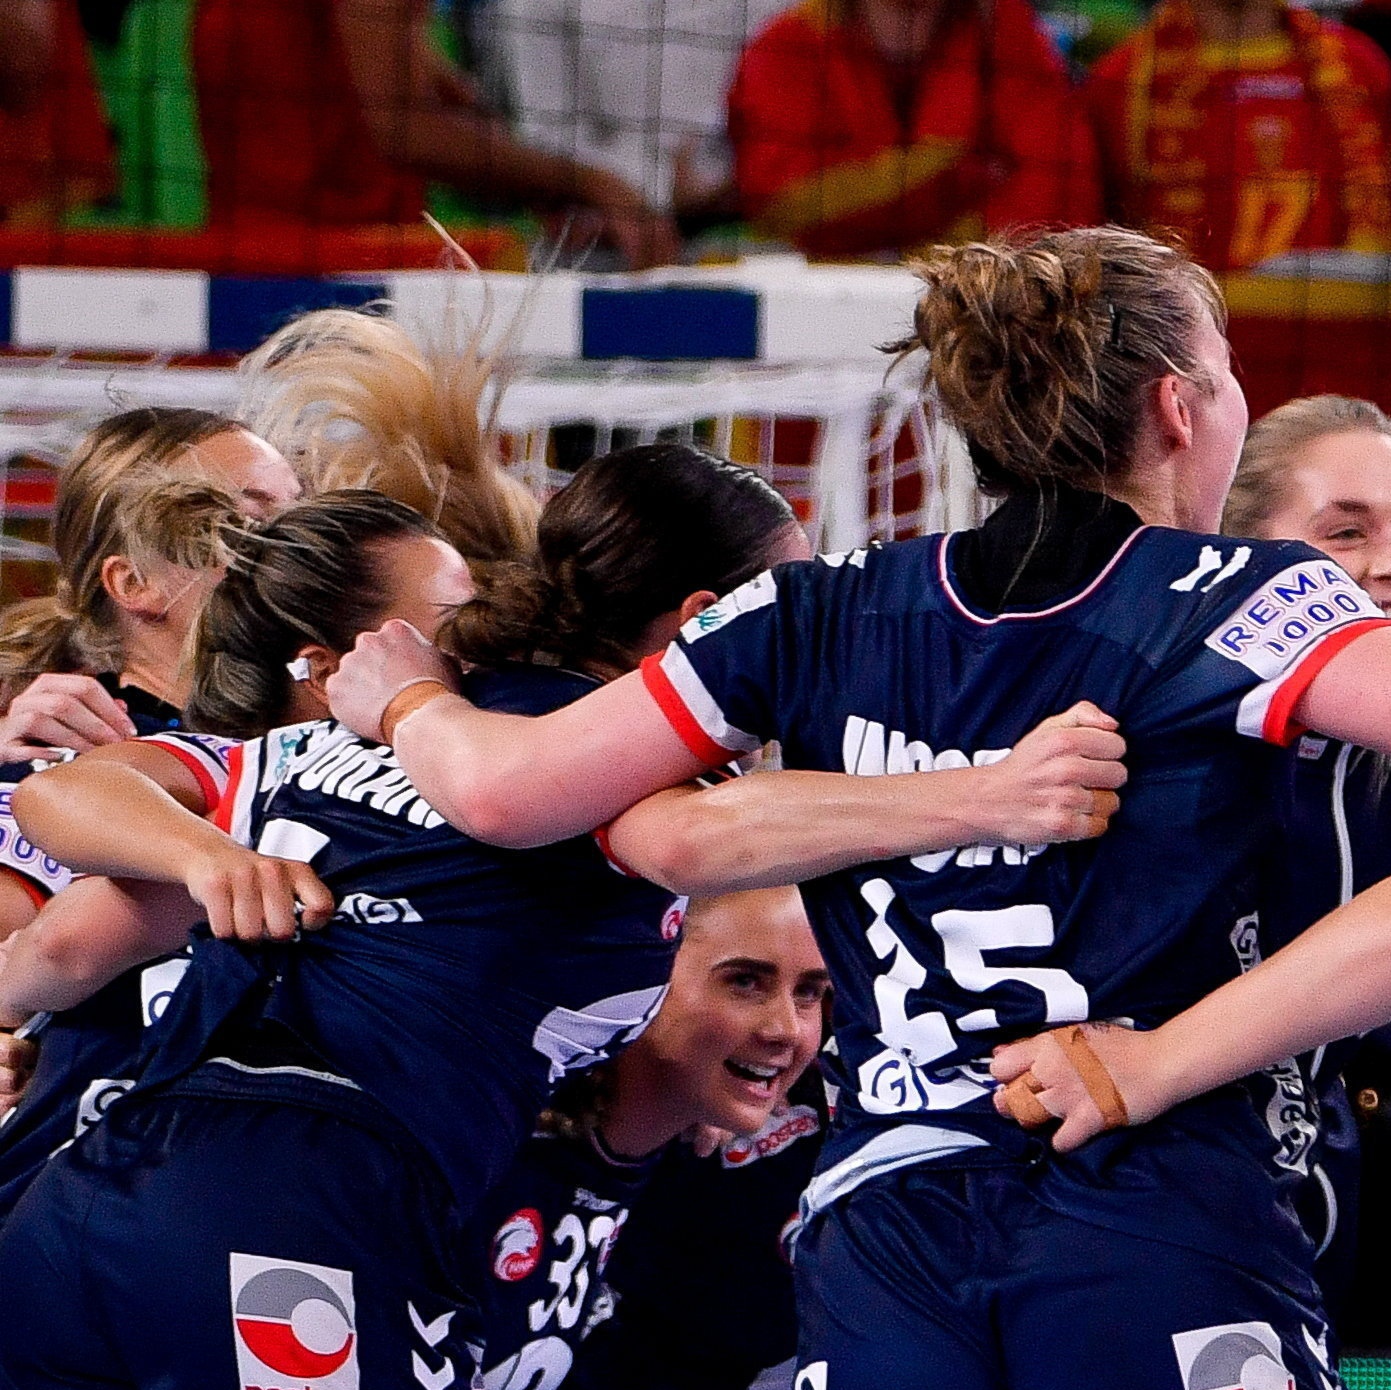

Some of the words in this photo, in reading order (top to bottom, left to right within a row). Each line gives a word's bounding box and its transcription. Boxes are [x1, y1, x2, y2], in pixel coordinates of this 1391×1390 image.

[1220, 567, 1348, 653] REMA
[1265, 592, 1361, 653] 1000
[859, 877, 1090, 1067] 15
